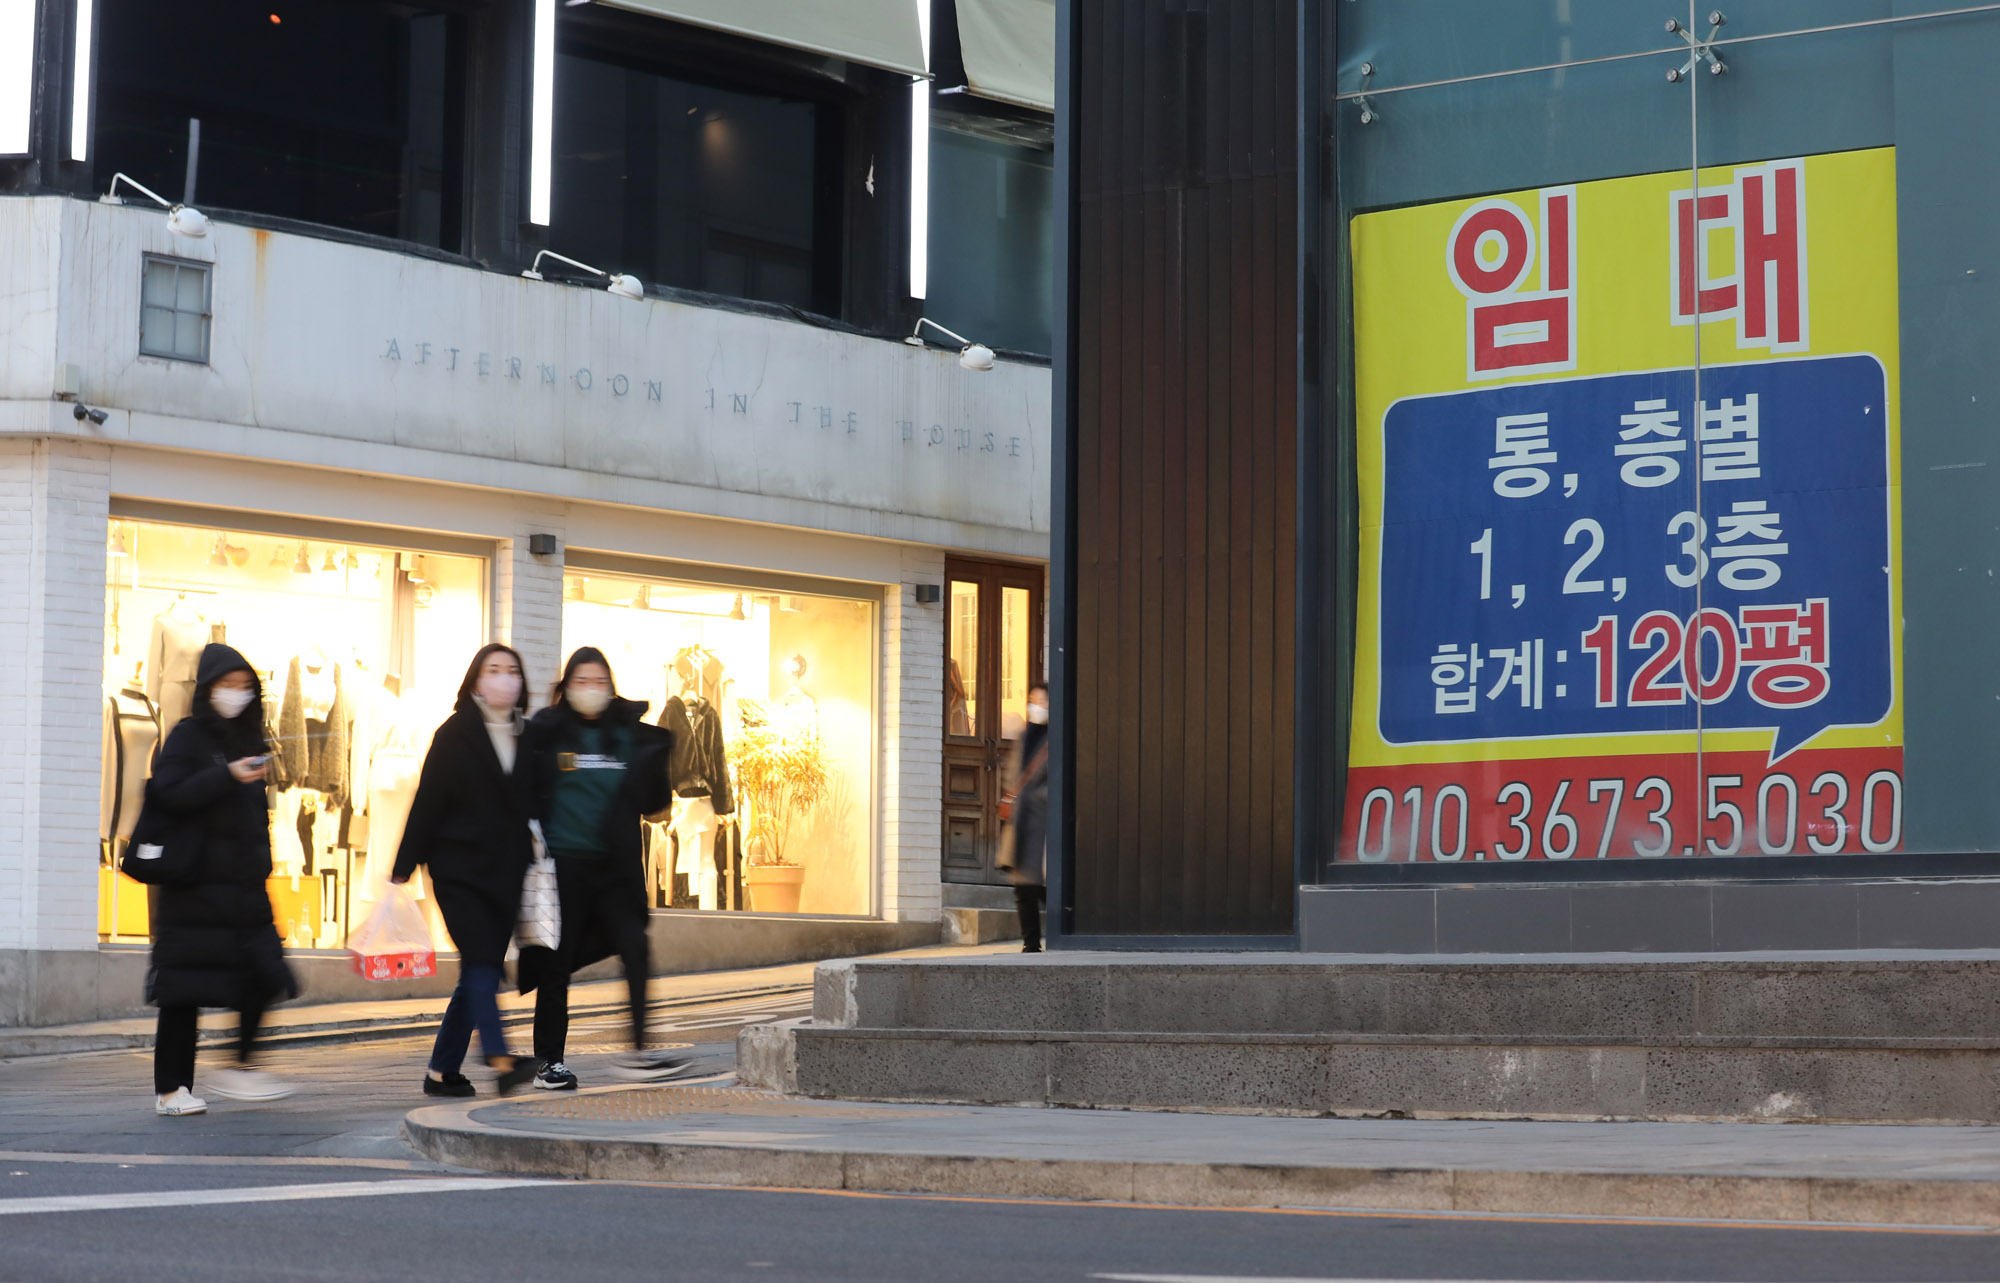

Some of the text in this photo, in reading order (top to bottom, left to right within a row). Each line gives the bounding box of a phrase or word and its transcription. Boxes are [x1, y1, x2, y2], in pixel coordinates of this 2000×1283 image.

[385, 337, 1020, 456] AFTERNOON IN THE HOUSE
[1488, 393, 1761, 498] 통, 층별
[1470, 501, 1789, 609] 1, 2, 3층
[1356, 770, 1902, 864] 010.3673.5030
